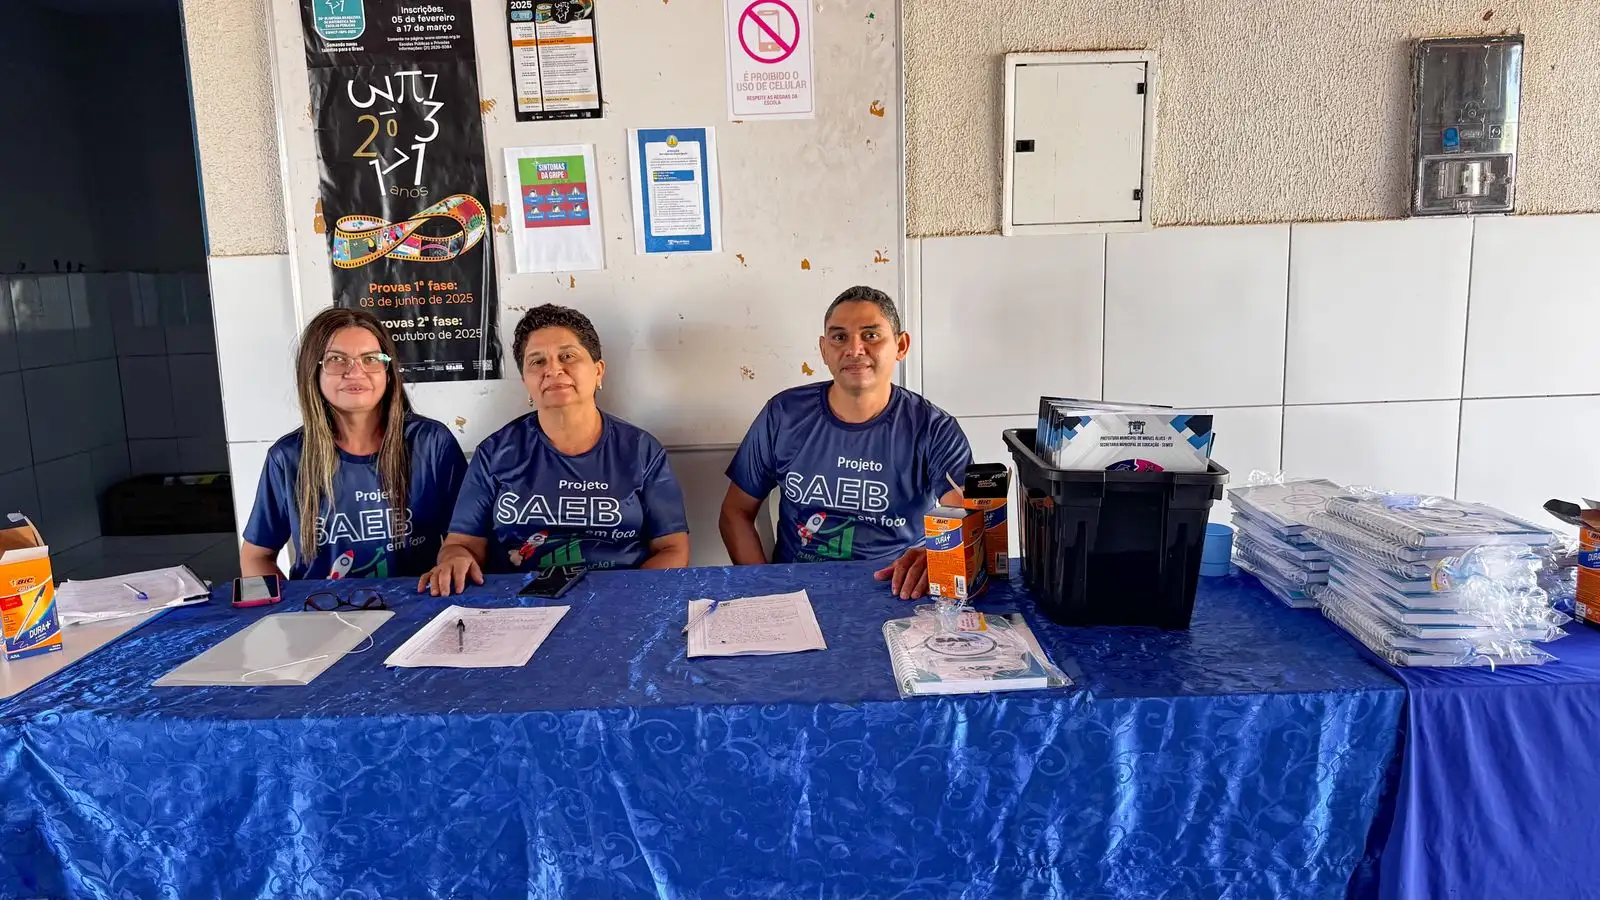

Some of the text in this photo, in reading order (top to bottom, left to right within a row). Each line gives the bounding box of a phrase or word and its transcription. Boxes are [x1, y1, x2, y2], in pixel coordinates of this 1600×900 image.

[401, 5, 444, 15] Inscrições:
[510, 1, 533, 9] 2025
[391, 14, 455, 24] 05 de fevereiro
[427, 24, 452, 32] março
[750, 72, 790, 81] PROIBIDO
[792, 70, 799, 80] O
[736, 80, 807, 92] USO DE CELULAR
[538, 162, 567, 172] SINTOMAS
[389, 185, 429, 198] anos
[369, 280, 458, 293] Provas 1ª fase:
[360, 293, 474, 308] 03 de junho de 2025
[379, 318, 414, 329] rovas
[433, 315, 463, 327] fase:
[391, 328, 482, 342] outubro de 2025
[837, 456, 883, 472] Projeto
[558, 480, 609, 491] Projeto
[785, 471, 890, 513] SAEB
[496, 491, 622, 527] SAEB
[857, 514, 907, 528] em foco
[611, 528, 636, 539] foco
[17, 577, 35, 585] BIC
[29, 621, 51, 638] DURA+
